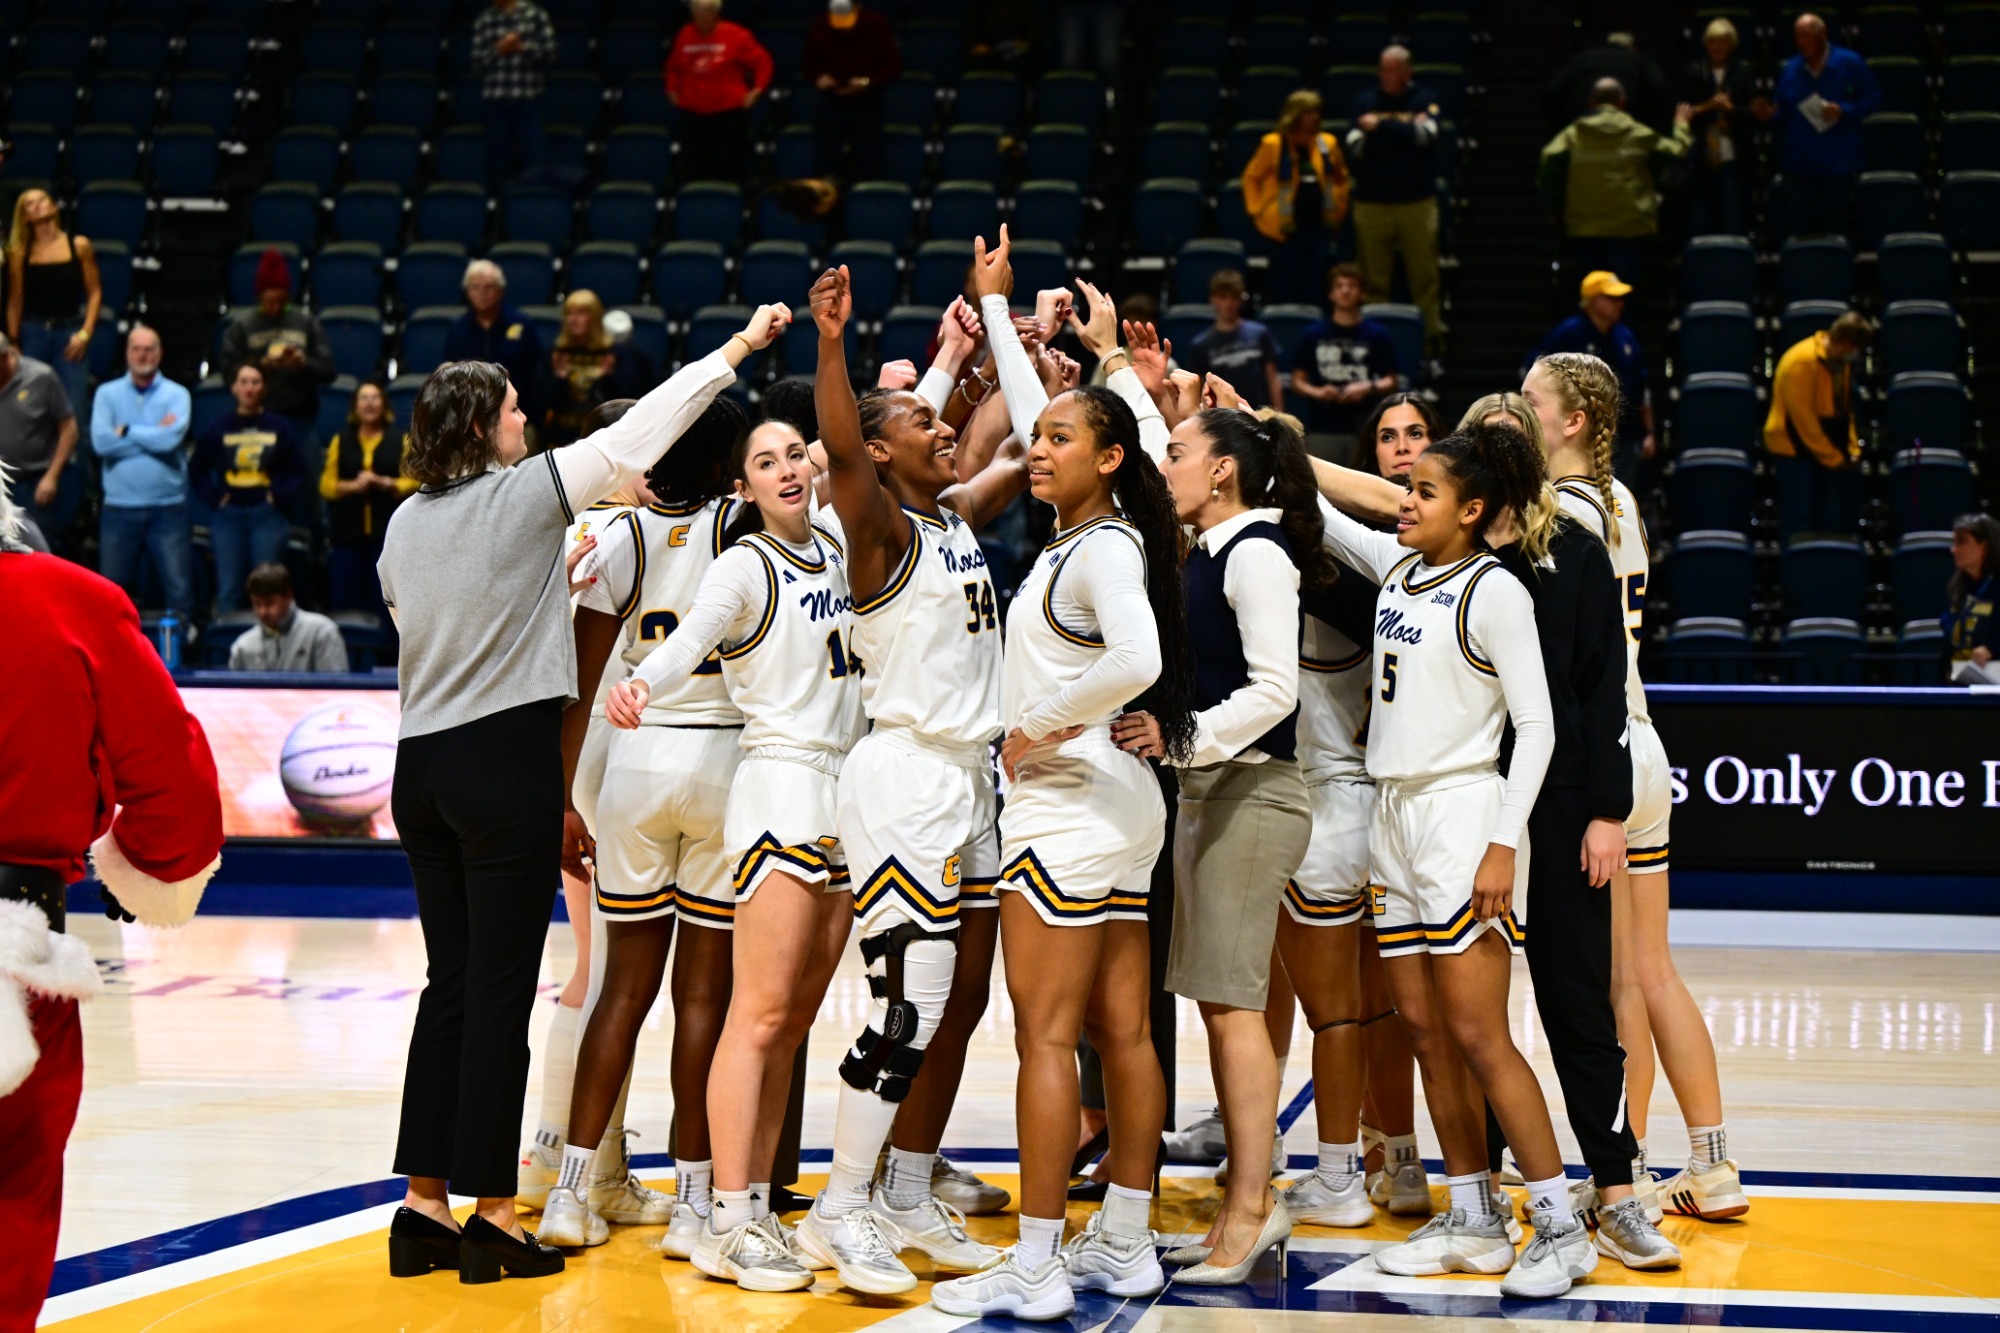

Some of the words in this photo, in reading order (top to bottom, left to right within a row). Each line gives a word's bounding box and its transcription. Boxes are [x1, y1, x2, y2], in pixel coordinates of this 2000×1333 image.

[668, 524, 691, 547] C
[938, 546, 986, 573] Mocs
[800, 588, 853, 622] Moc
[963, 579, 996, 634] 34
[1376, 607, 1422, 645] Mocs
[1616, 571, 1645, 642] 5
[1381, 651, 1398, 704] 5
[1704, 754, 1836, 815] Only
[1851, 757, 1965, 807] One
